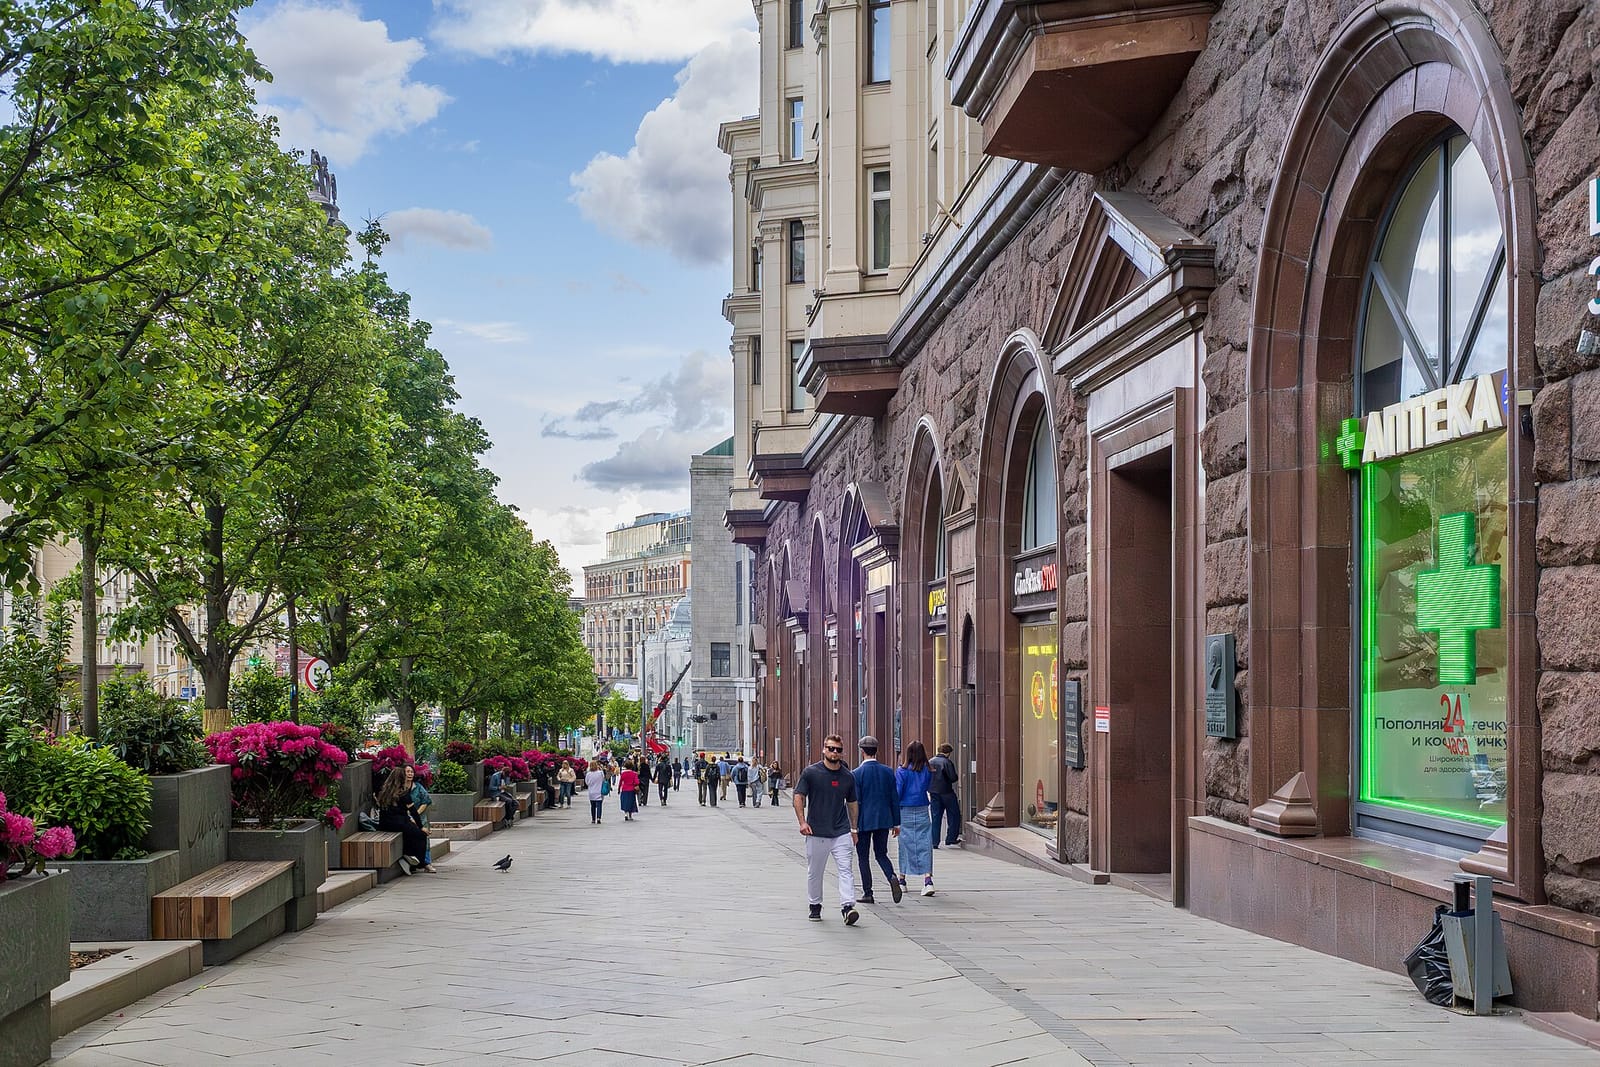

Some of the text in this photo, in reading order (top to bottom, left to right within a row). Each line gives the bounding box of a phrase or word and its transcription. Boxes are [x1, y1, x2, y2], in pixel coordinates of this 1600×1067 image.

[1362, 374, 1503, 463] АПТЕКА
[1440, 693, 1465, 733] 24
[1412, 737, 1421, 746] и
[1444, 737, 1470, 756] часа
